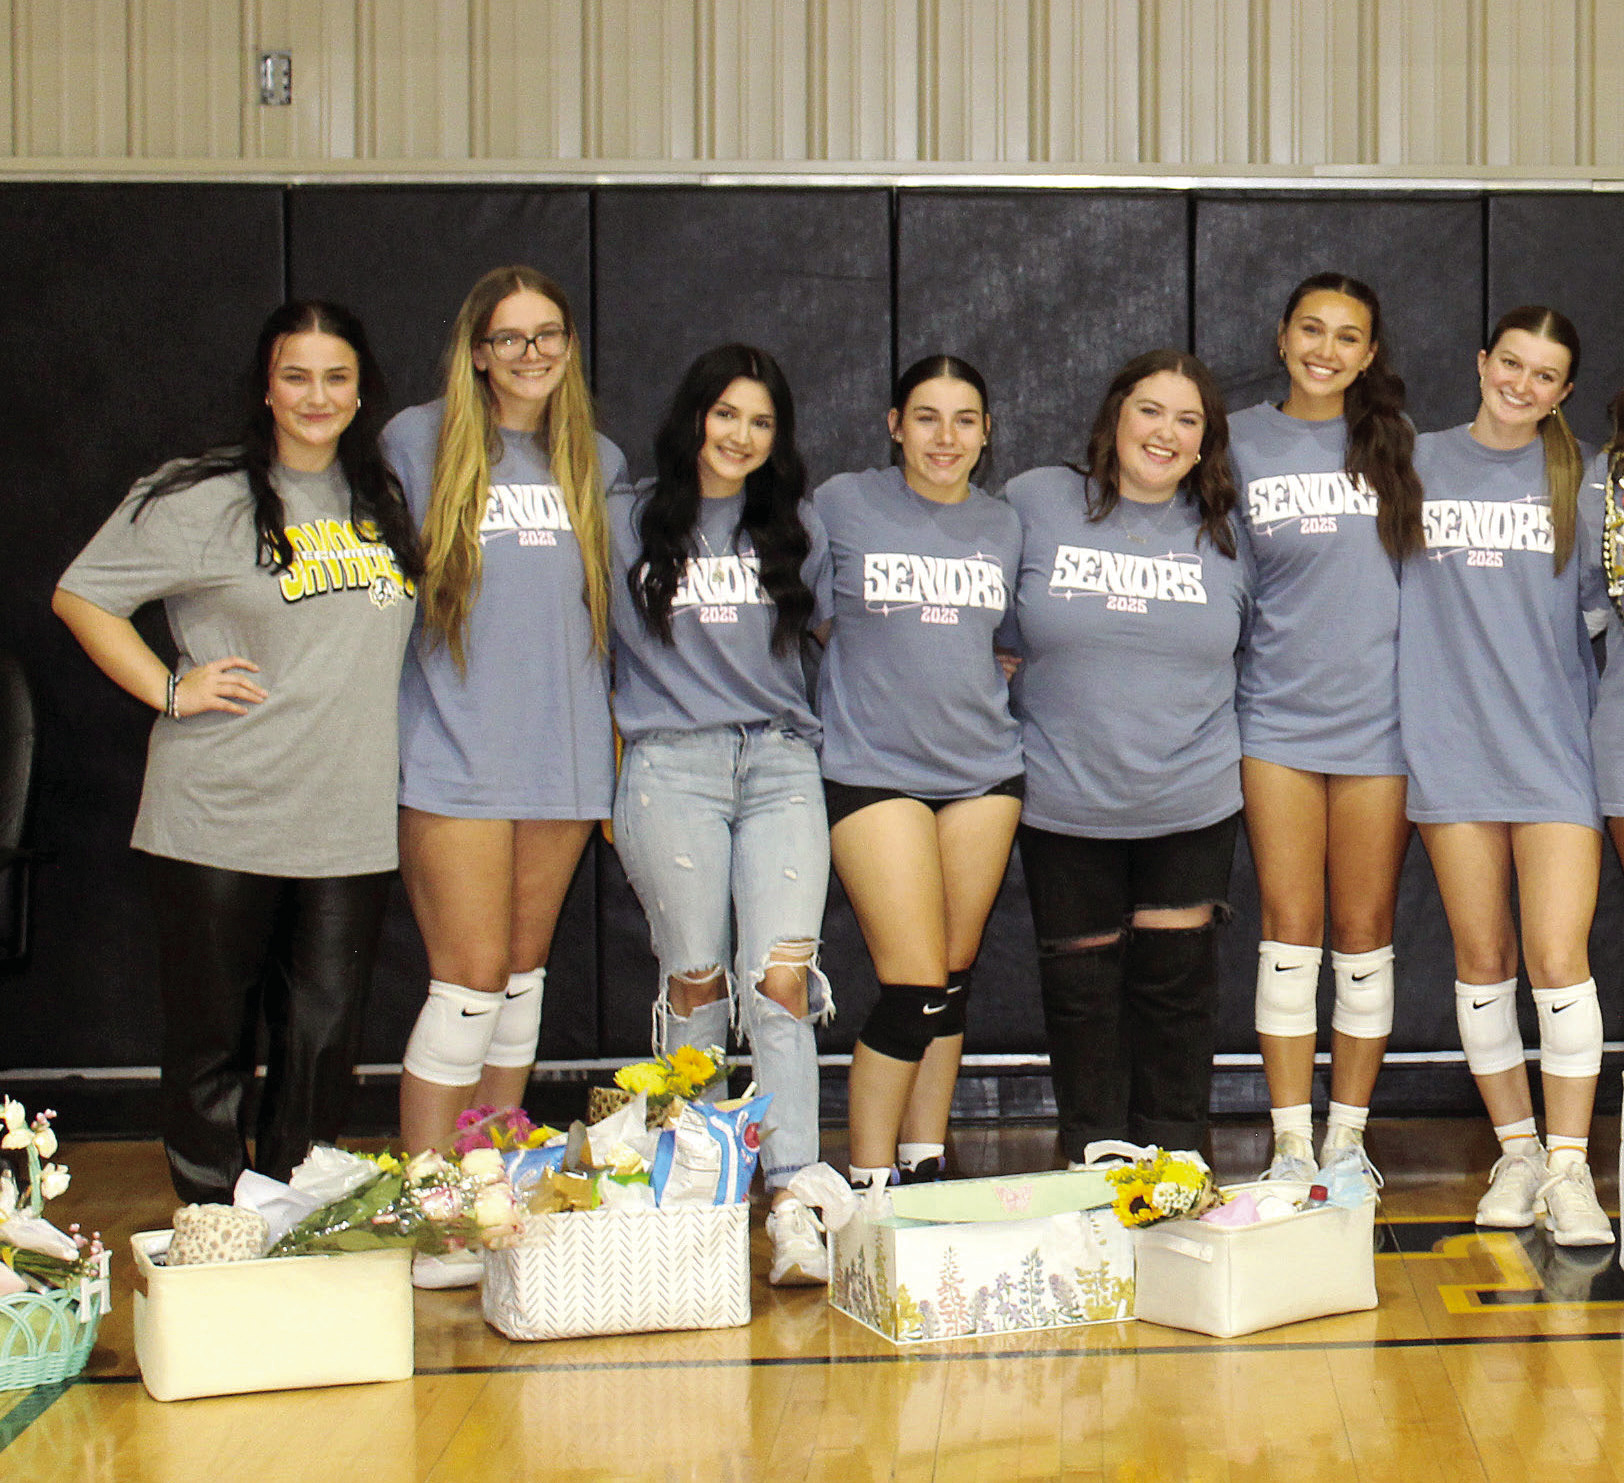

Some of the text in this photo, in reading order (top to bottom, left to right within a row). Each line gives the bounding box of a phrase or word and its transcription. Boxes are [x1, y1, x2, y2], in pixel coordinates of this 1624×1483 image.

[480, 484, 573, 531] ENIO
[1248, 471, 1378, 525] SENIOR
[517, 529, 558, 547] 2025
[1301, 516, 1338, 534] 2025
[1422, 499, 1556, 554] SENIORS
[1050, 544, 1208, 605] SENIORS
[1466, 549, 1504, 569] 2025
[650, 554, 775, 605] NIOR
[864, 552, 1006, 612] SENIORS
[700, 604, 739, 624] 2025
[920, 604, 960, 626] 2025
[1105, 594, 1149, 615] 2025
